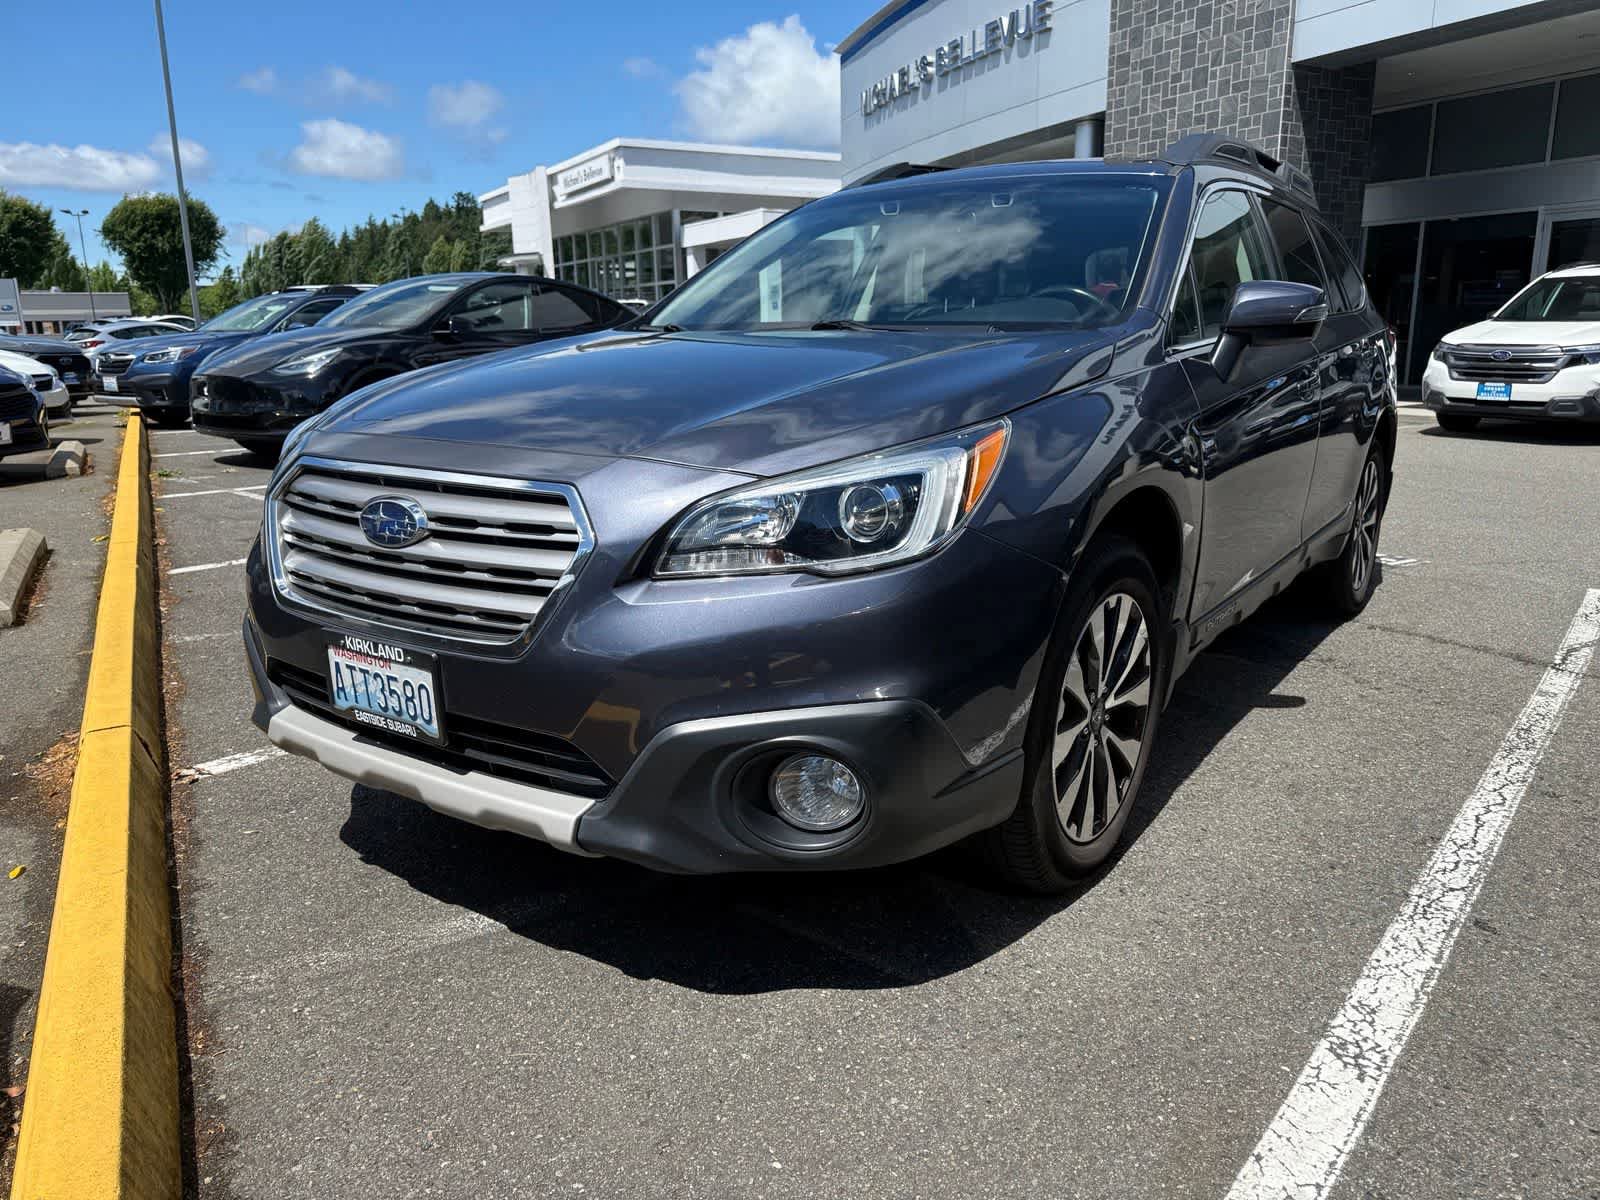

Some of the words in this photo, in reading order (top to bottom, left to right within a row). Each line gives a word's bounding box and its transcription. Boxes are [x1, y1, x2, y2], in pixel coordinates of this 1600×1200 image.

[860, 54, 934, 116] MICHAEL'S
[935, 0, 1053, 77] BELLEVUE
[345, 636, 404, 662] KIRKLAND
[334, 661, 433, 726] ATT3580
[354, 710, 387, 728] EASTSIDE
[387, 719, 416, 737] SUBARU
